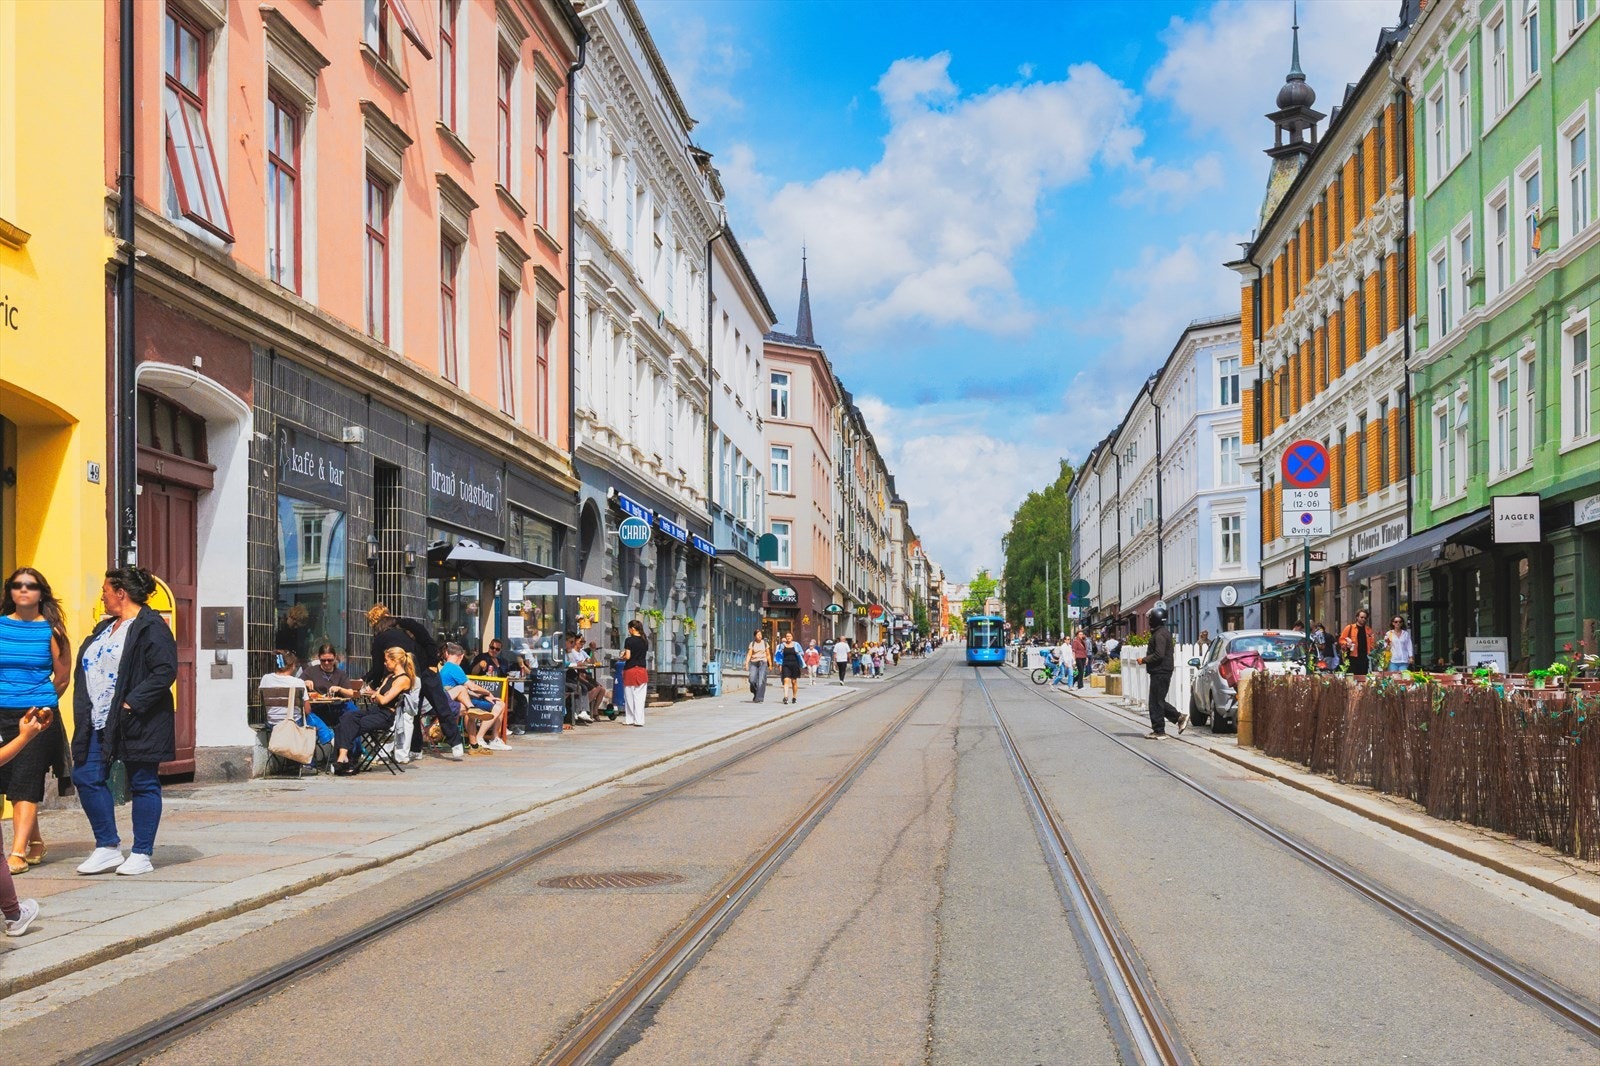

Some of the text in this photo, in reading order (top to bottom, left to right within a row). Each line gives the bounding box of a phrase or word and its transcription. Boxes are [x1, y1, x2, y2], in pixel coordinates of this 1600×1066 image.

[89, 464, 100, 481] 49
[292, 447, 344, 487] kafé & bar
[430, 462, 494, 511] brauð toastbar
[1308, 490, 1319, 498] 06
[1293, 500, 1320, 508] (12-06)
[1499, 513, 1535, 521] JAGGER
[621, 524, 648, 540] CHAIR
[1381, 523, 1404, 544] Vintage
